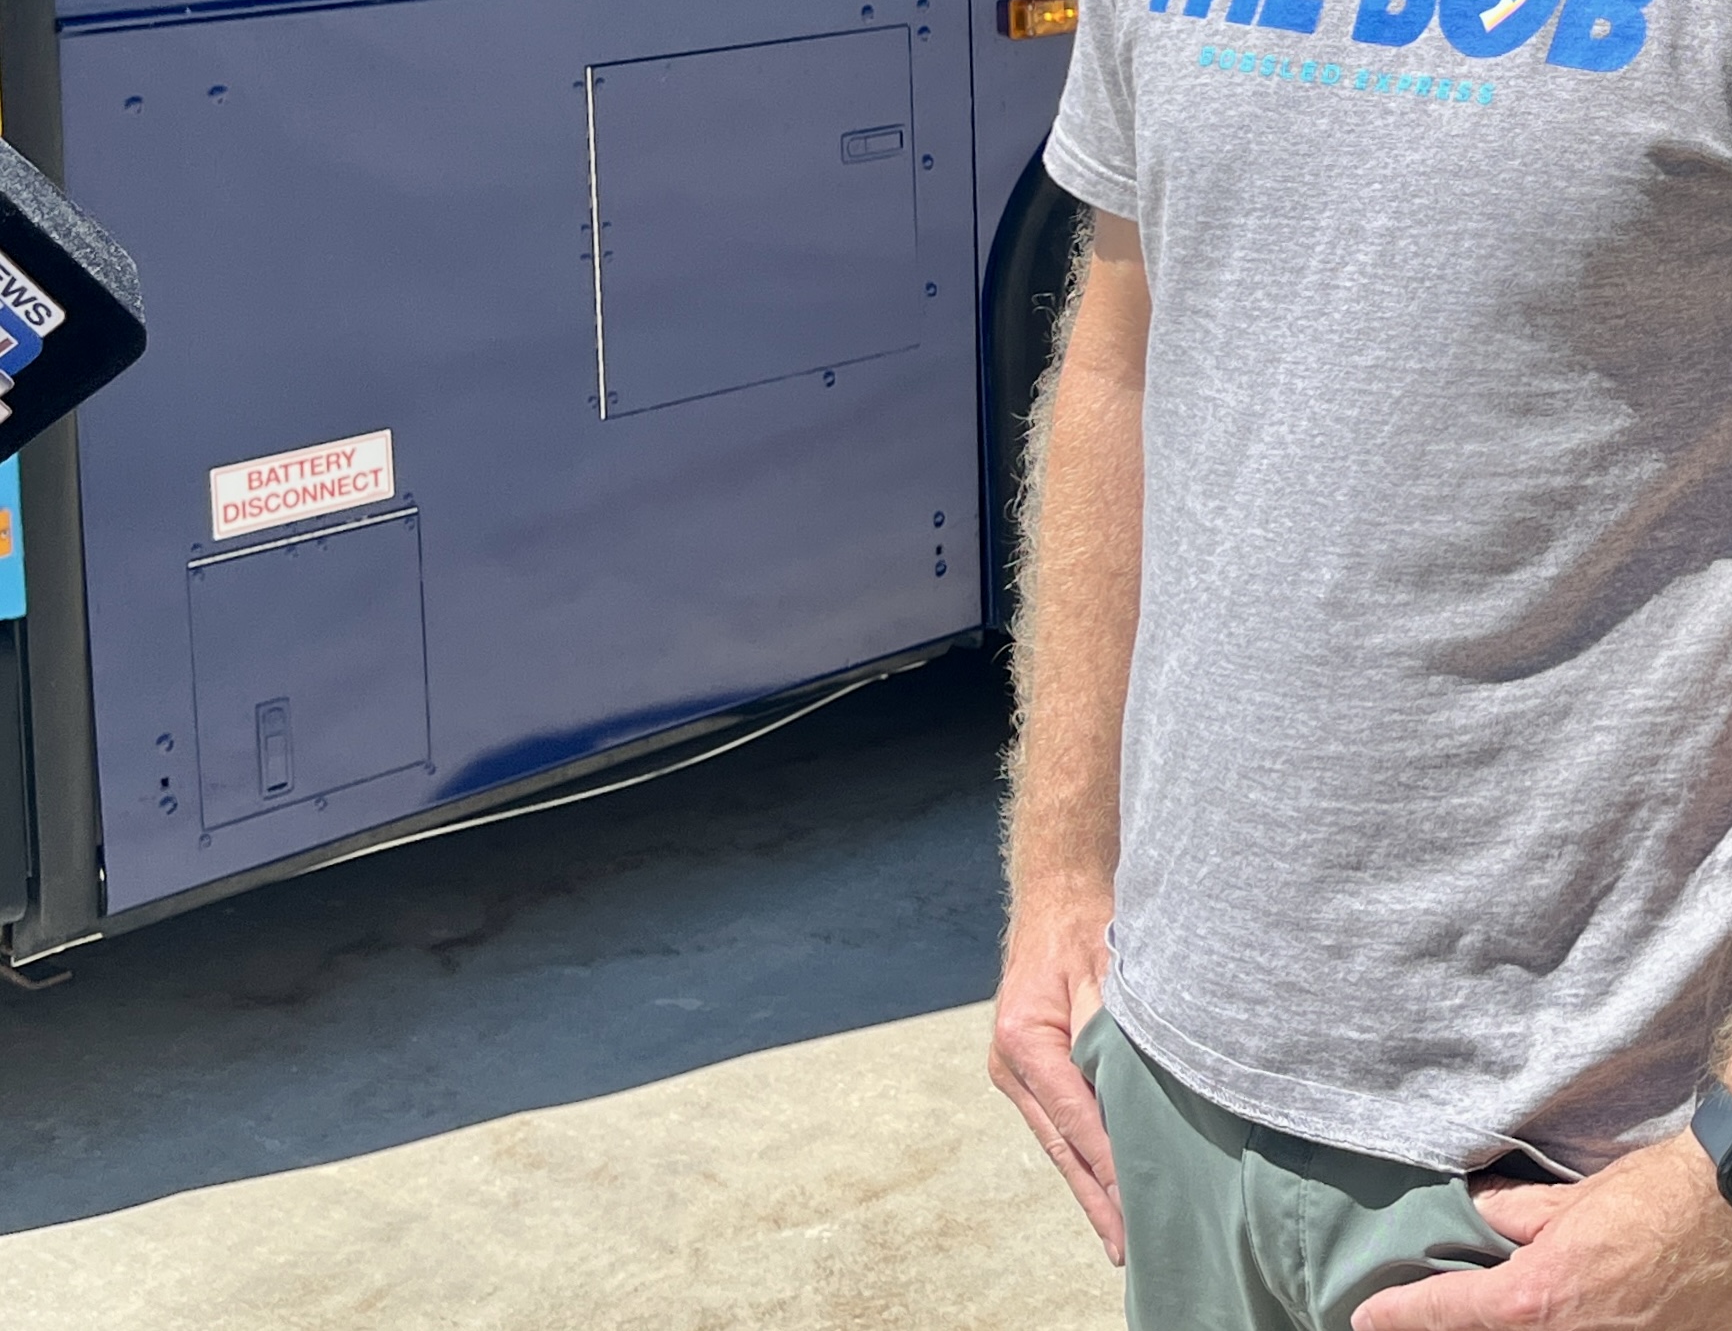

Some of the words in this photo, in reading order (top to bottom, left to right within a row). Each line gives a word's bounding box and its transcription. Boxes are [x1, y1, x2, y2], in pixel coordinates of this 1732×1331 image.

[1199, 45, 1342, 85] BOBSLED
[1354, 69, 1496, 105] EXPRESS
[223, 468, 384, 524] DISCONNECT
[247, 448, 357, 491] BATTERY
